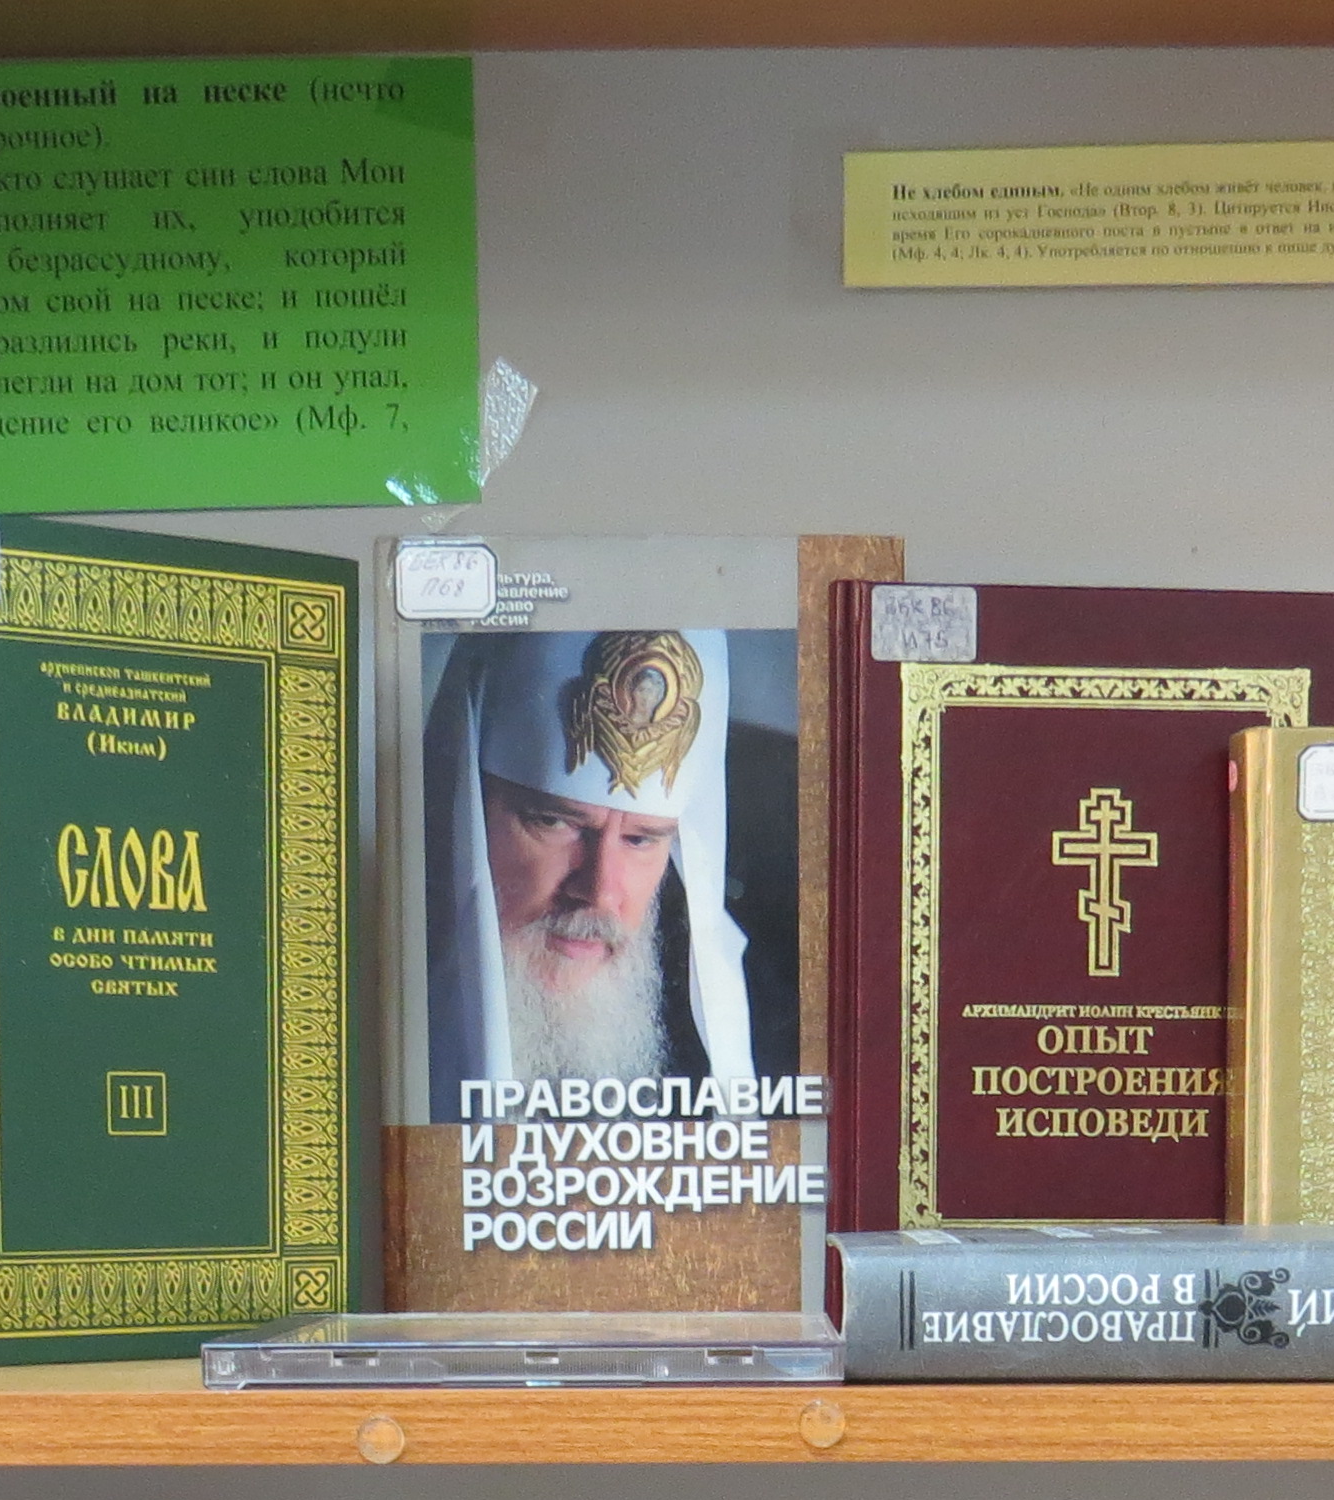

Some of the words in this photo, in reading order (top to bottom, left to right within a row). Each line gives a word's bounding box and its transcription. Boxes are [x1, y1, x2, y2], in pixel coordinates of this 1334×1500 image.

[142, 83, 179, 105] на
[203, 82, 288, 104] песке
[309, 78, 405, 105] (нечто
[54, 165, 172, 195] слушает
[185, 167, 236, 188] сии
[248, 164, 328, 186] слова
[340, 160, 405, 185] Мои
[892, 183, 918, 202] Не
[923, 180, 985, 201] хлебом
[57, 701, 196, 731] ВЛАДИМИР
[87, 734, 167, 761] (Иким)
[57, 823, 207, 913] СЛОВА
[53, 926, 66, 943] В
[73, 926, 116, 946] ДНИ
[123, 927, 214, 948] ПАМЯТИ
[50, 952, 113, 971] ОСОБО
[120, 954, 217, 974] ЧТИМЫХ
[90, 977, 178, 997] СВЯТЫХ
[962, 1004, 1076, 1020] АРХИМАНДРИТ
[1079, 1005, 1133, 1018] ИОАНН
[1136, 1005, 1222, 1020] КРЕСТЬЯНК
[1037, 1025, 1154, 1054] ОПЫТ
[460, 1075, 825, 1119] ПРАВОСЛАВИЕ
[972, 1066, 1225, 1096] ПОСТРОЕНИЯ
[120, 1085, 154, 1120] III
[996, 1108, 1209, 1143] ИСПОВЕДИ
[461, 1124, 493, 1163] И
[509, 1121, 768, 1170] ДУХОВНОЕ
[462, 1165, 825, 1213] ВОЗРОЖДЕНИЕ
[463, 1210, 653, 1252] РОССИИ
[1005, 1272, 1169, 1306] РОССИИ
[1175, 1272, 1195, 1304] В
[923, 1310, 1197, 1343] ПРАВОСЛАВИЕ
